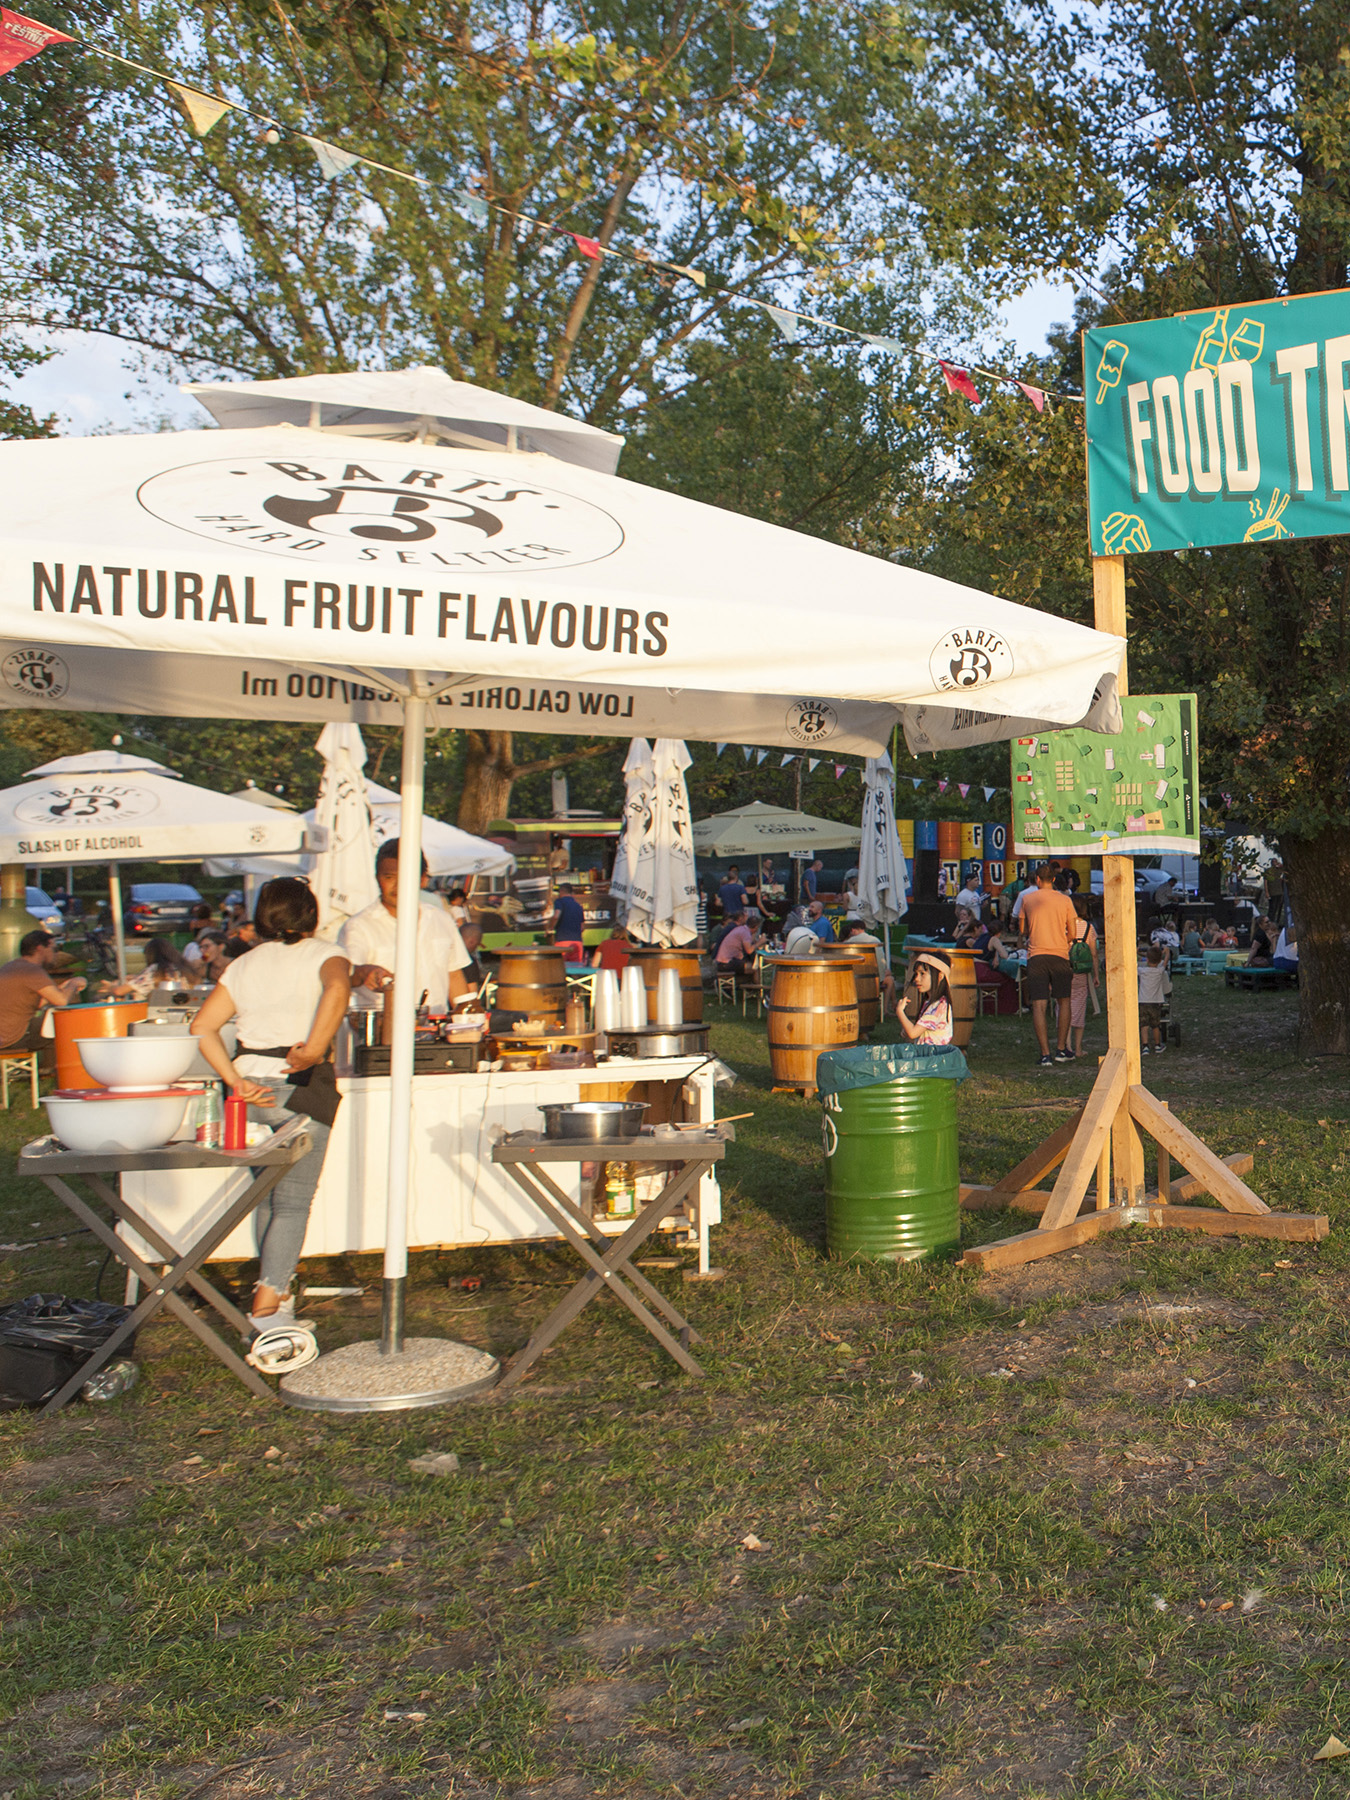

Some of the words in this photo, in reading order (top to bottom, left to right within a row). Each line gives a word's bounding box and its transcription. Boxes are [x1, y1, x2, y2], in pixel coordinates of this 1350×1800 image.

[1127, 359, 1260, 494] FOOD
[265, 461, 543, 503] BARTS
[194, 514, 326, 552] HARD
[357, 542, 572, 566] SELTZER
[32, 561, 267, 626] NATURAL
[285, 579, 423, 636] FRUIT
[438, 591, 670, 658] FLAVOURS
[951, 629, 1003, 653] BARTS
[50, 785, 138, 799] BARTS
[18, 840, 61, 855] SLASH
[65, 838, 81, 852] OF
[84, 835, 144, 851] ALCOHOL
